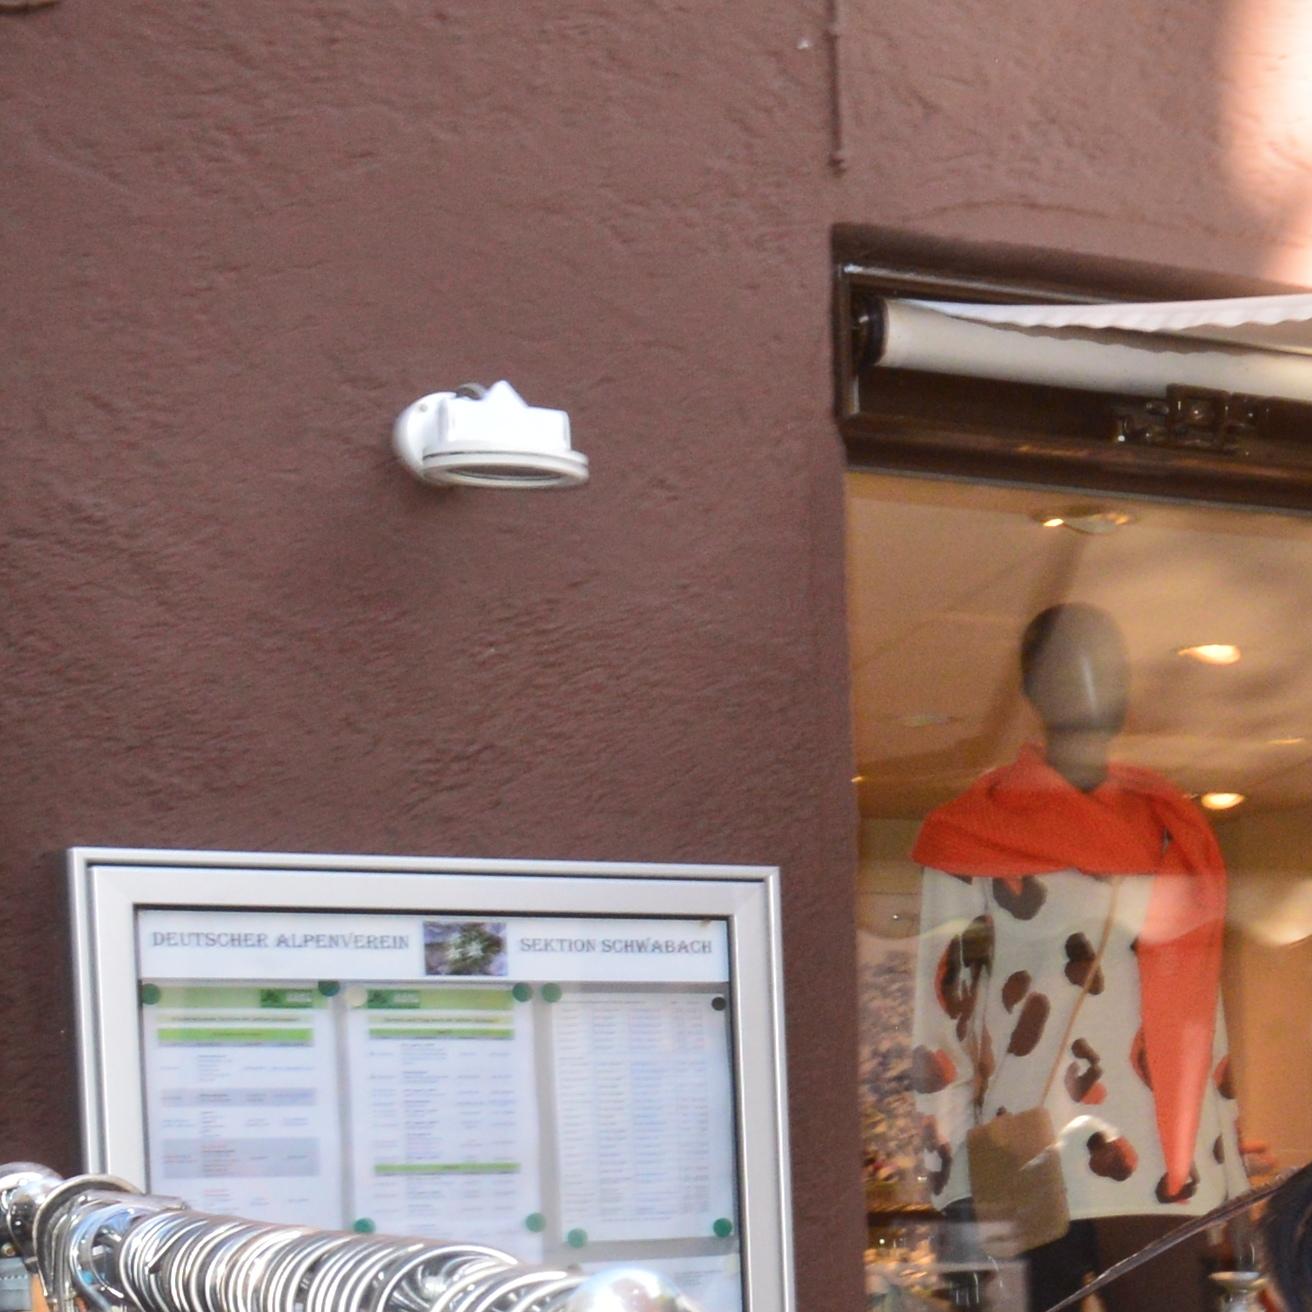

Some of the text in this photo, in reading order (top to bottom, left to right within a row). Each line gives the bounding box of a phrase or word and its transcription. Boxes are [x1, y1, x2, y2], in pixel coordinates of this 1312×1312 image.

[152, 930, 712, 955] DEUTSCHER ALPENVEREIN SEKTION SCHWABACH
